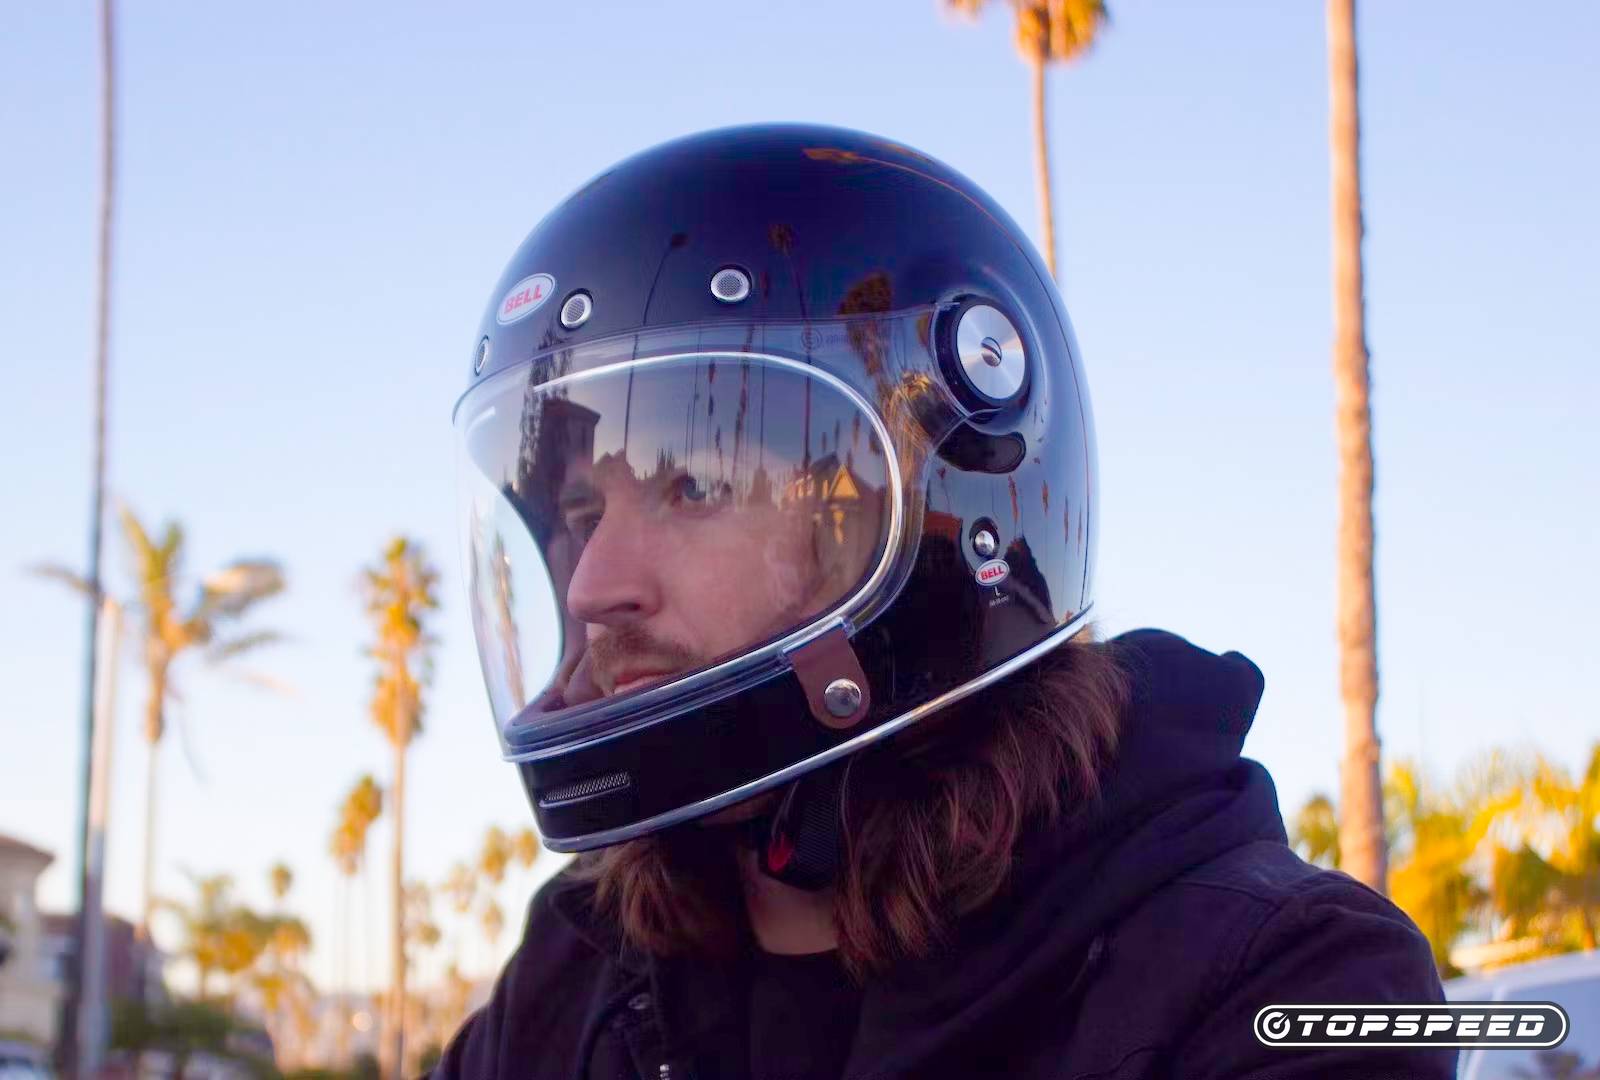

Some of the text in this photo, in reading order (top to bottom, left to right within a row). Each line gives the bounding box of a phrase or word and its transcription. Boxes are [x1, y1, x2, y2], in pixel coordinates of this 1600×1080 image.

[504, 284, 542, 314] BELL
[981, 566, 1004, 580] BELL
[994, 586, 1000, 597] L
